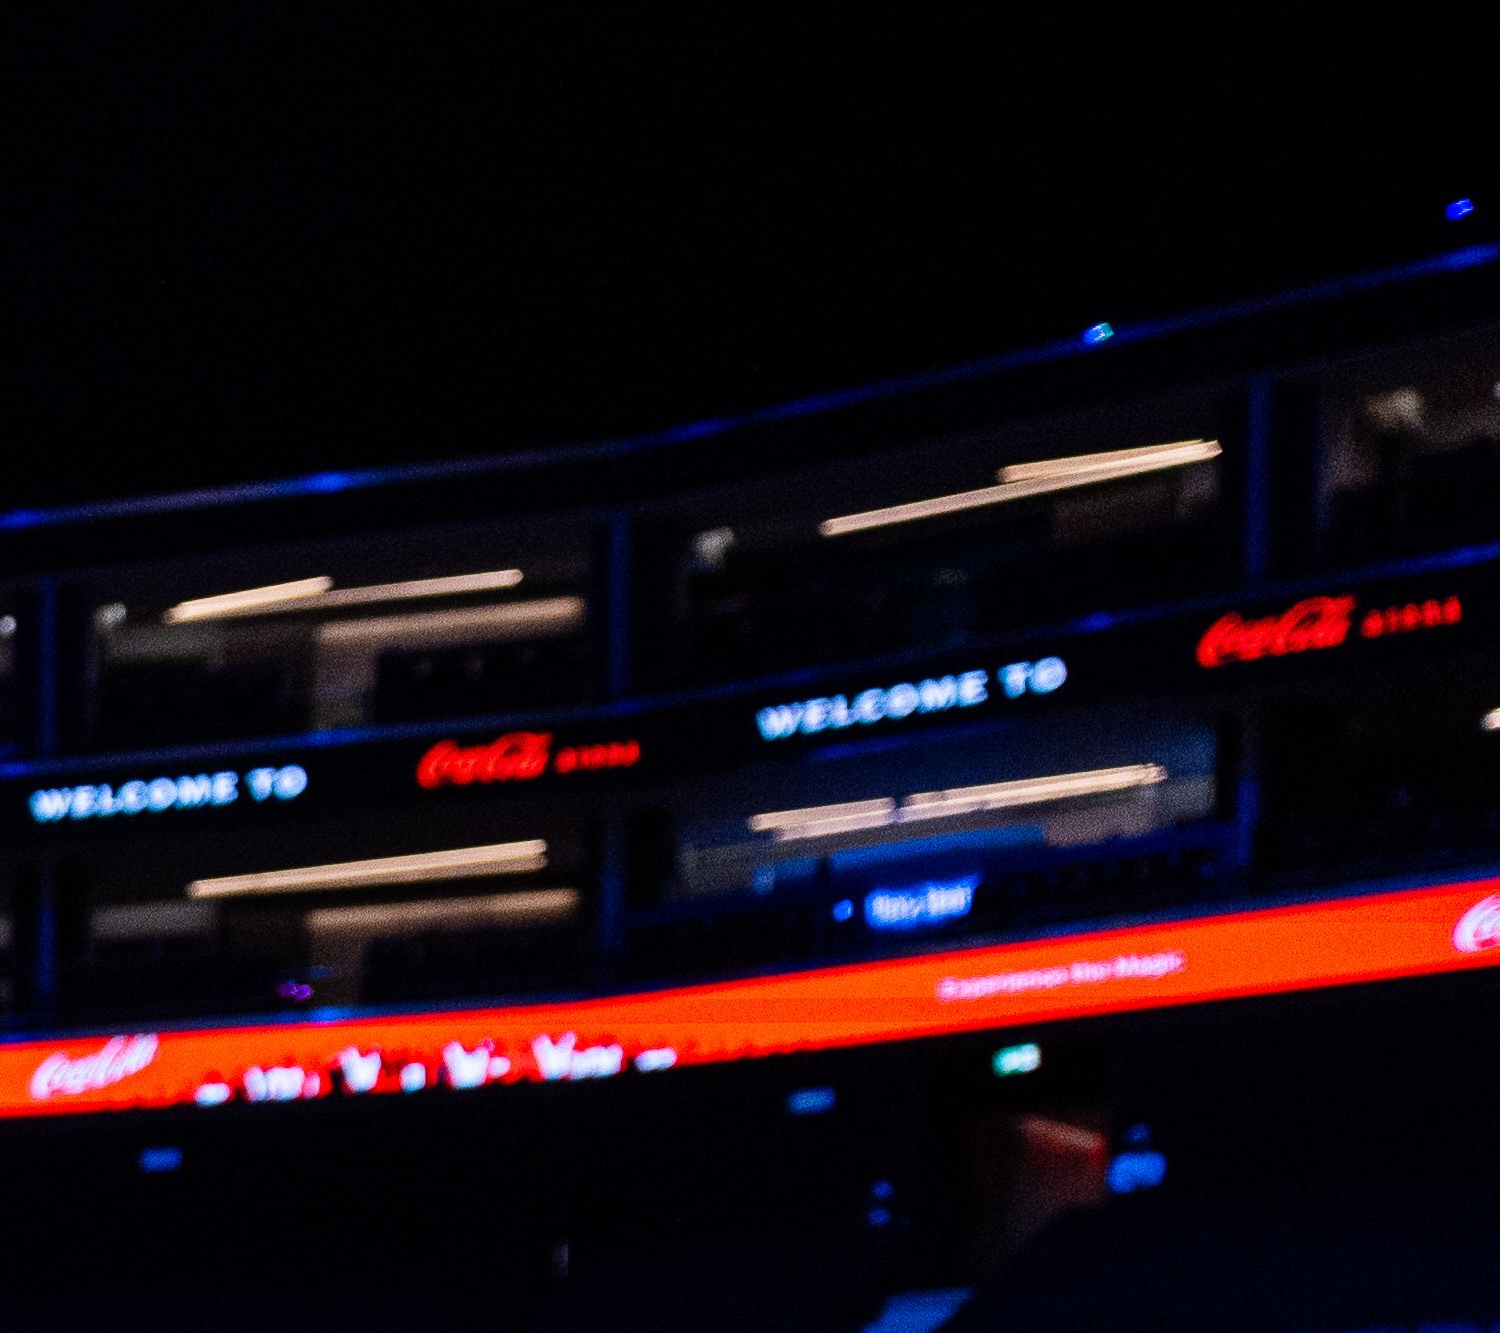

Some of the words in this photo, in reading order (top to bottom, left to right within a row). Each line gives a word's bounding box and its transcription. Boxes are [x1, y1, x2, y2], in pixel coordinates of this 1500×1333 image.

[757, 669, 989, 738] WELCOME
[1000, 656, 1067, 697] TO
[31, 770, 239, 821] WELCOME
[250, 763, 308, 801] TO
